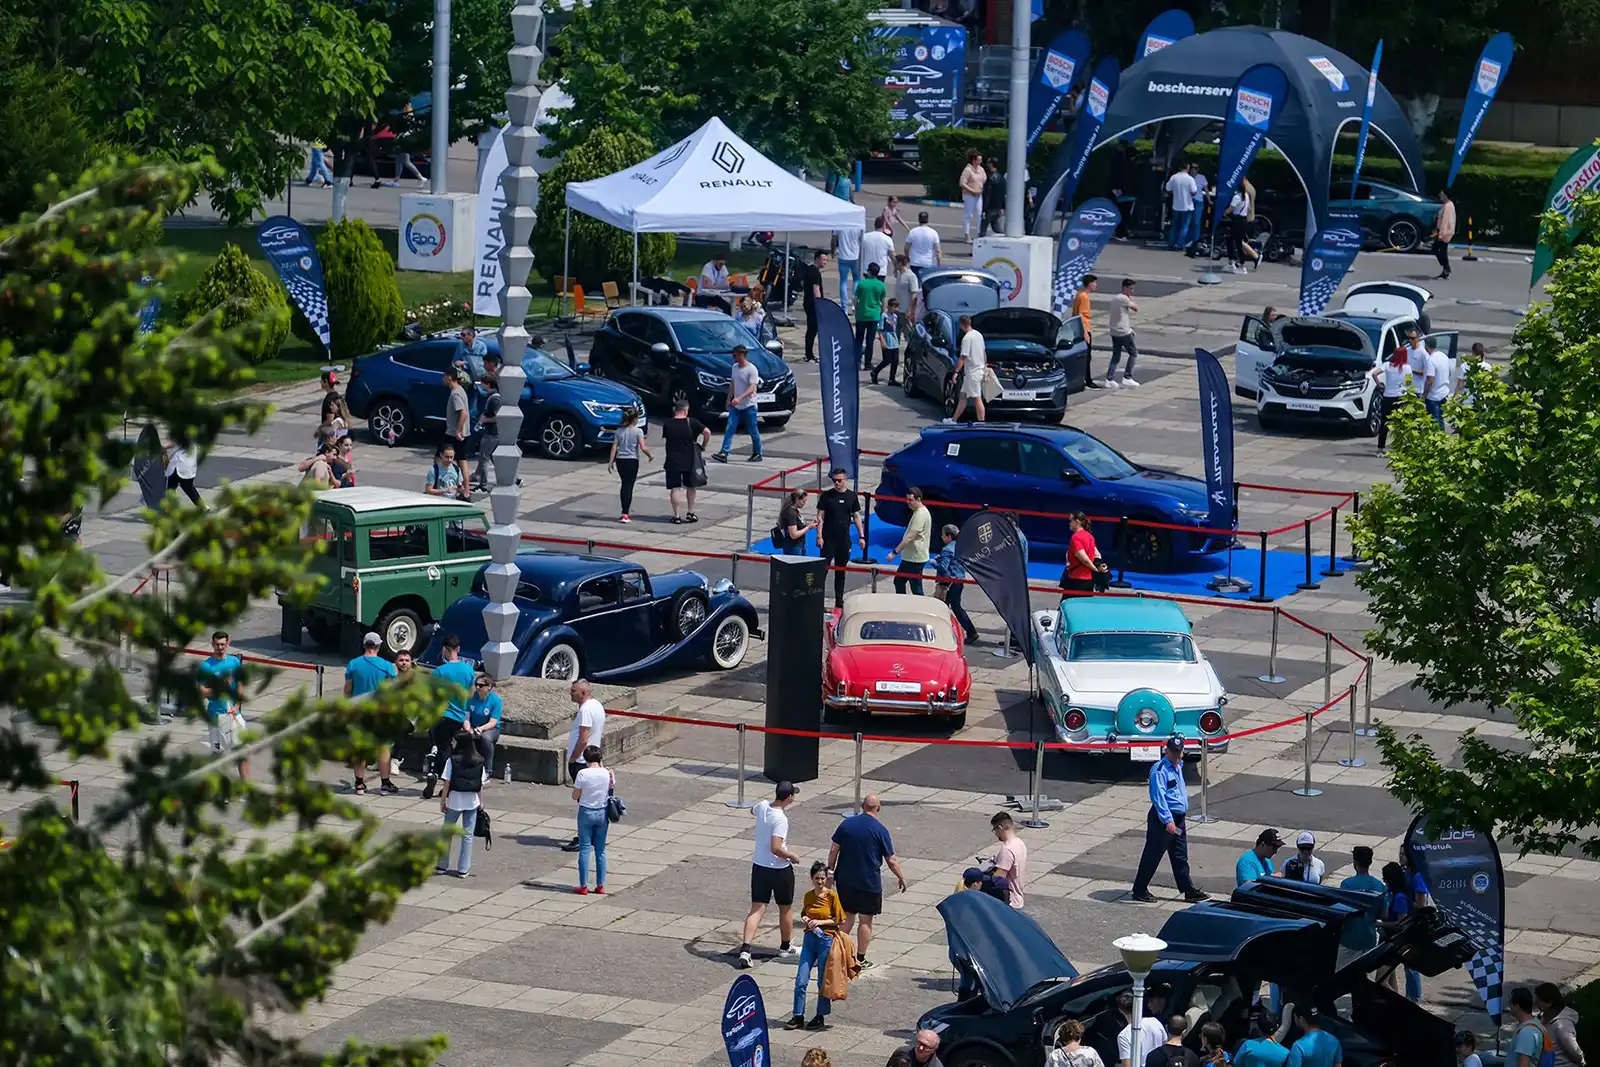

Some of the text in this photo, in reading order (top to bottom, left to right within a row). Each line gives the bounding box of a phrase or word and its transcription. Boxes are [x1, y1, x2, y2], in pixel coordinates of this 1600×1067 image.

[1047, 54, 1073, 70] BOSCH
[1046, 64, 1071, 80] Service
[1091, 82, 1108, 99] BOSCH
[1147, 81, 1233, 96] boschcarserv
[1239, 92, 1270, 107] BOSCH
[1238, 102, 1269, 117] Service
[700, 179, 773, 188] RENAULT
[1226, 163, 1243, 188] Pentru
[1564, 152, 1600, 200] Castro
